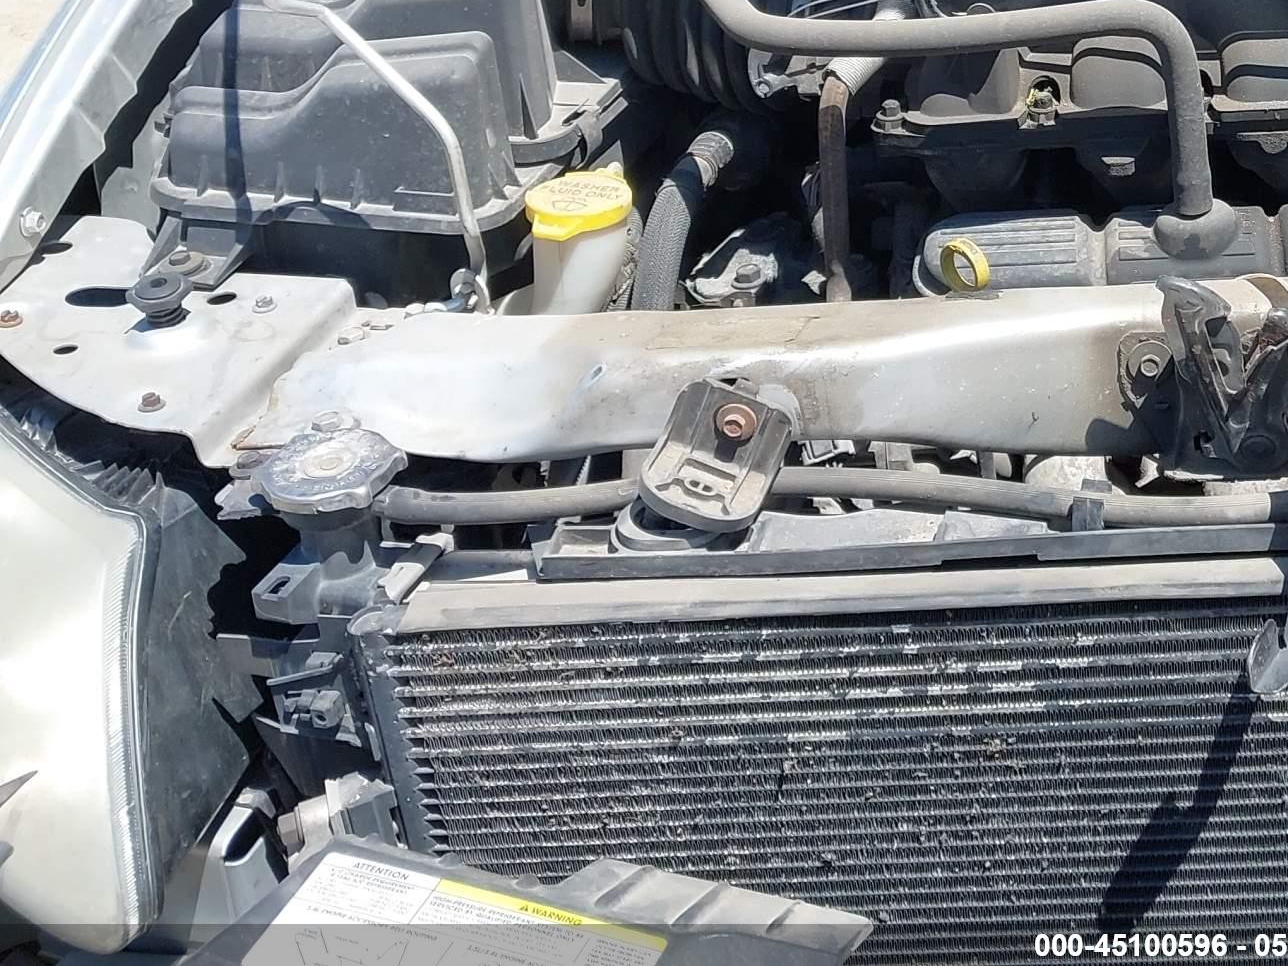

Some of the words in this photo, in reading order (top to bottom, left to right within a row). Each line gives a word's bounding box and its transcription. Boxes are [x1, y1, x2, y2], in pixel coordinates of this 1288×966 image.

[541, 185, 582, 195] FLUID
[585, 190, 624, 200] ONLY
[559, 179, 621, 192] WASHER
[352, 861, 410, 881] ATTENTION
[531, 907, 583, 926] WARNING
